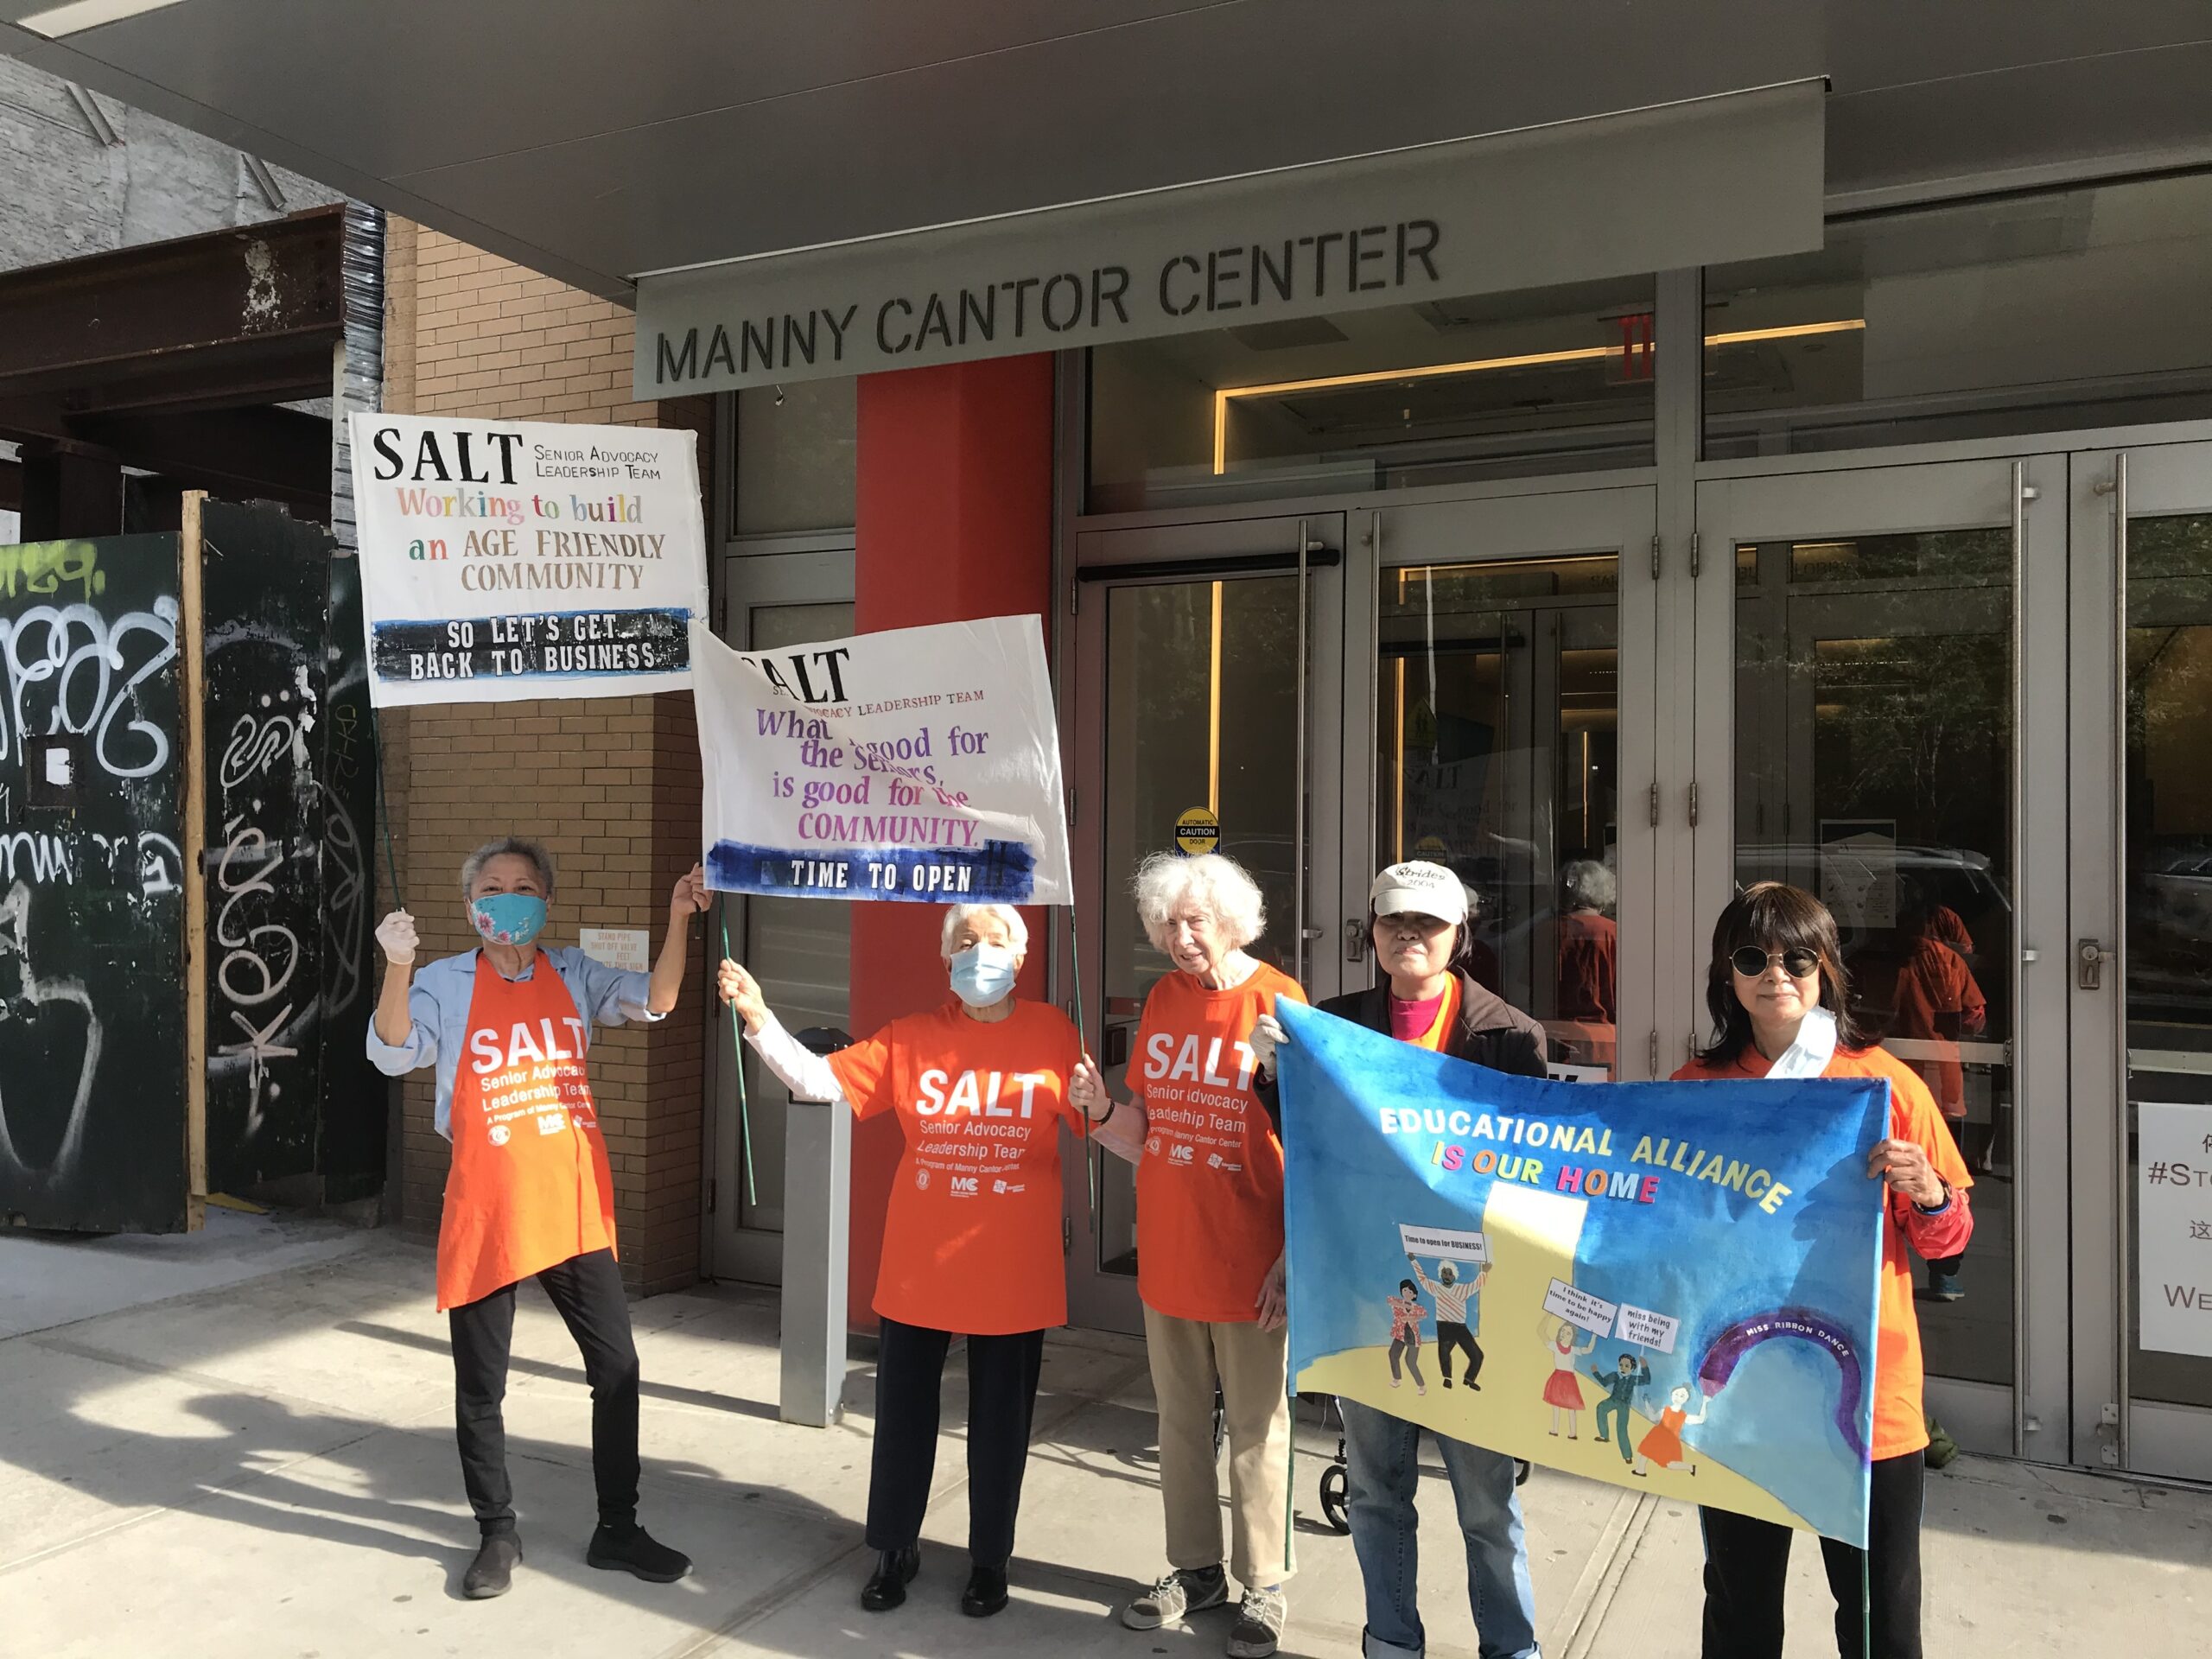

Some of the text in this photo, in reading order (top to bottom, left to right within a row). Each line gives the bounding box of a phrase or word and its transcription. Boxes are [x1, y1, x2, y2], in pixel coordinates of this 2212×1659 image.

[656, 220, 1440, 384] MANNY CANTOR CENTER
[374, 428, 522, 485] SALT
[397, 487, 642, 524] Working to build
[409, 530, 665, 561] an AGE FRIENDLY
[461, 563, 644, 591] COMMUNITY
[448, 613, 616, 648] SO LET'S GET
[410, 642, 655, 680] BACK TO BUSINESS
[859, 694, 942, 715] LEADERSHIP
[946, 690, 984, 705] TEAM
[801, 740, 842, 767] the
[948, 726, 988, 756] for
[772, 772, 794, 798] is
[802, 776, 870, 808] good
[888, 778, 925, 806] for
[798, 813, 978, 846] COMMUNITY.
[791, 860, 972, 893] TIME TO OPEN
[620, 943, 637, 951] VALVE
[470, 1017, 584, 1074] SALT
[1144, 1033, 1255, 1092] SALT
[481, 1065, 585, 1092] Senior Advoca
[1147, 1084, 1185, 1101] Senior
[482, 1084, 561, 1112] Leadership
[916, 1069, 1046, 1118] SALT
[919, 1120, 1032, 1141] Senior Advocacy
[1210, 1113, 1246, 1133] Team
[917, 1140, 988, 1160] Leadership
[1379, 1107, 1792, 1214] EDUCATIONAL ALLIANCE
[1431, 1141, 1661, 1204] IS OUR HOME
[2148, 1161, 2212, 1187] #ST
[1404, 1235, 1419, 1243] Time
[1452, 1240, 1483, 1250] BUSINESS!
[1549, 1290, 1567, 1302] time
[1577, 1302, 1586, 1312] be
[1588, 1307, 1612, 1324] happy
[1567, 1288, 1587, 1302] think
[1591, 1299, 1603, 1309] it's
[1565, 1308, 1590, 1322] again!
[1627, 1309, 1671, 1329] miss being
[1629, 1321, 1665, 1338] with my
[1629, 1330, 1662, 1347] friends!
[1746, 1321, 1849, 1357] MISS RIBBON DANCE
